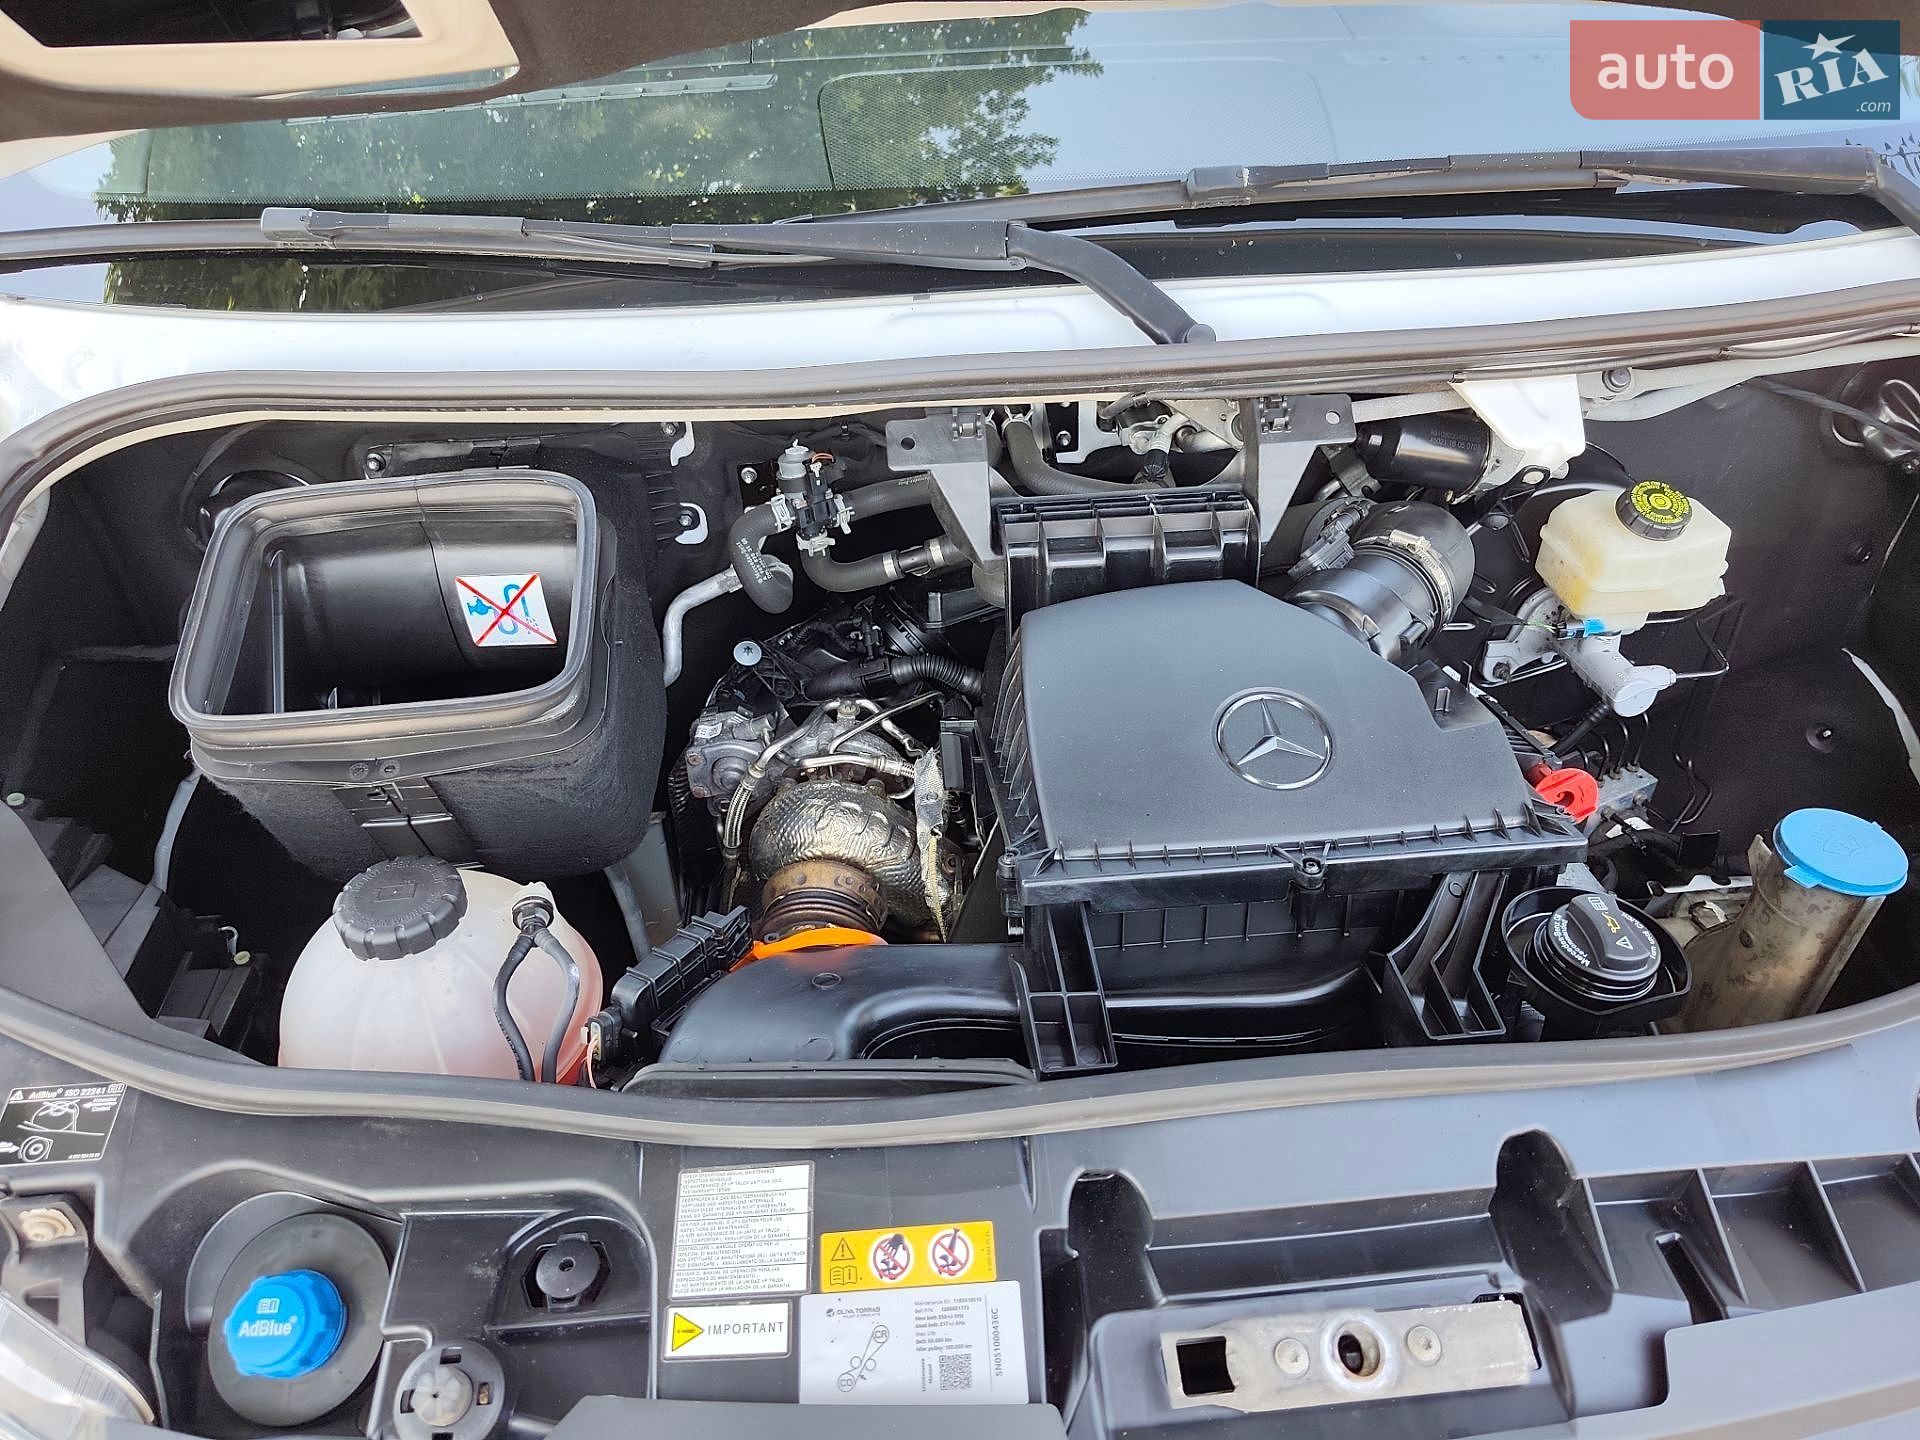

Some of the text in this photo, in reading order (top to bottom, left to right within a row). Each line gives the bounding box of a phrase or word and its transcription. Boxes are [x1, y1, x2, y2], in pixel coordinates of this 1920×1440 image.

[1553, 921, 1590, 966] Mercedes-Benz
[708, 1322, 784, 1335] IMPORTANT
[875, 1330, 887, 1338] CR
